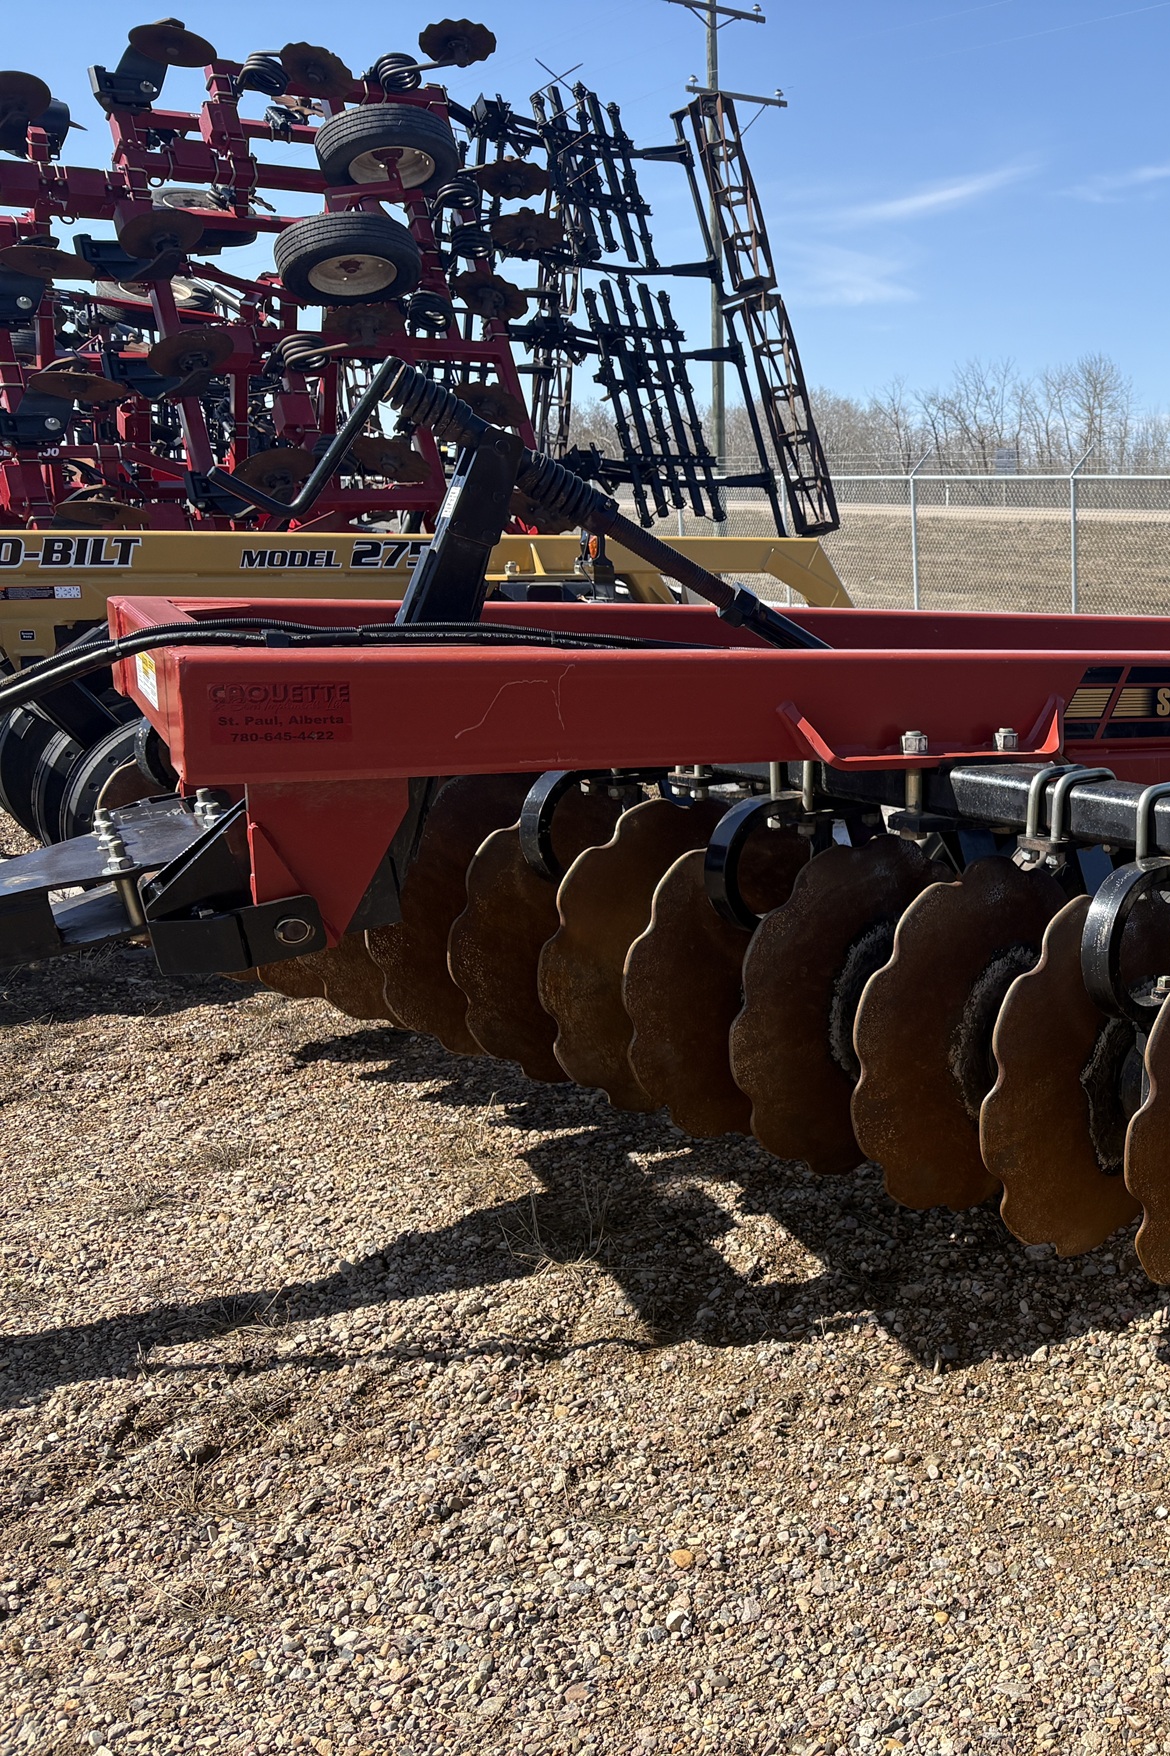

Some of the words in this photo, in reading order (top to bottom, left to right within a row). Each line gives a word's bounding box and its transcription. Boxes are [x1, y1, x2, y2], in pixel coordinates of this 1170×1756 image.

[239, 549, 343, 569] MODEL
[218, 716, 239, 726] St.
[244, 715, 284, 727] Paul,
[288, 715, 344, 726] Alberta
